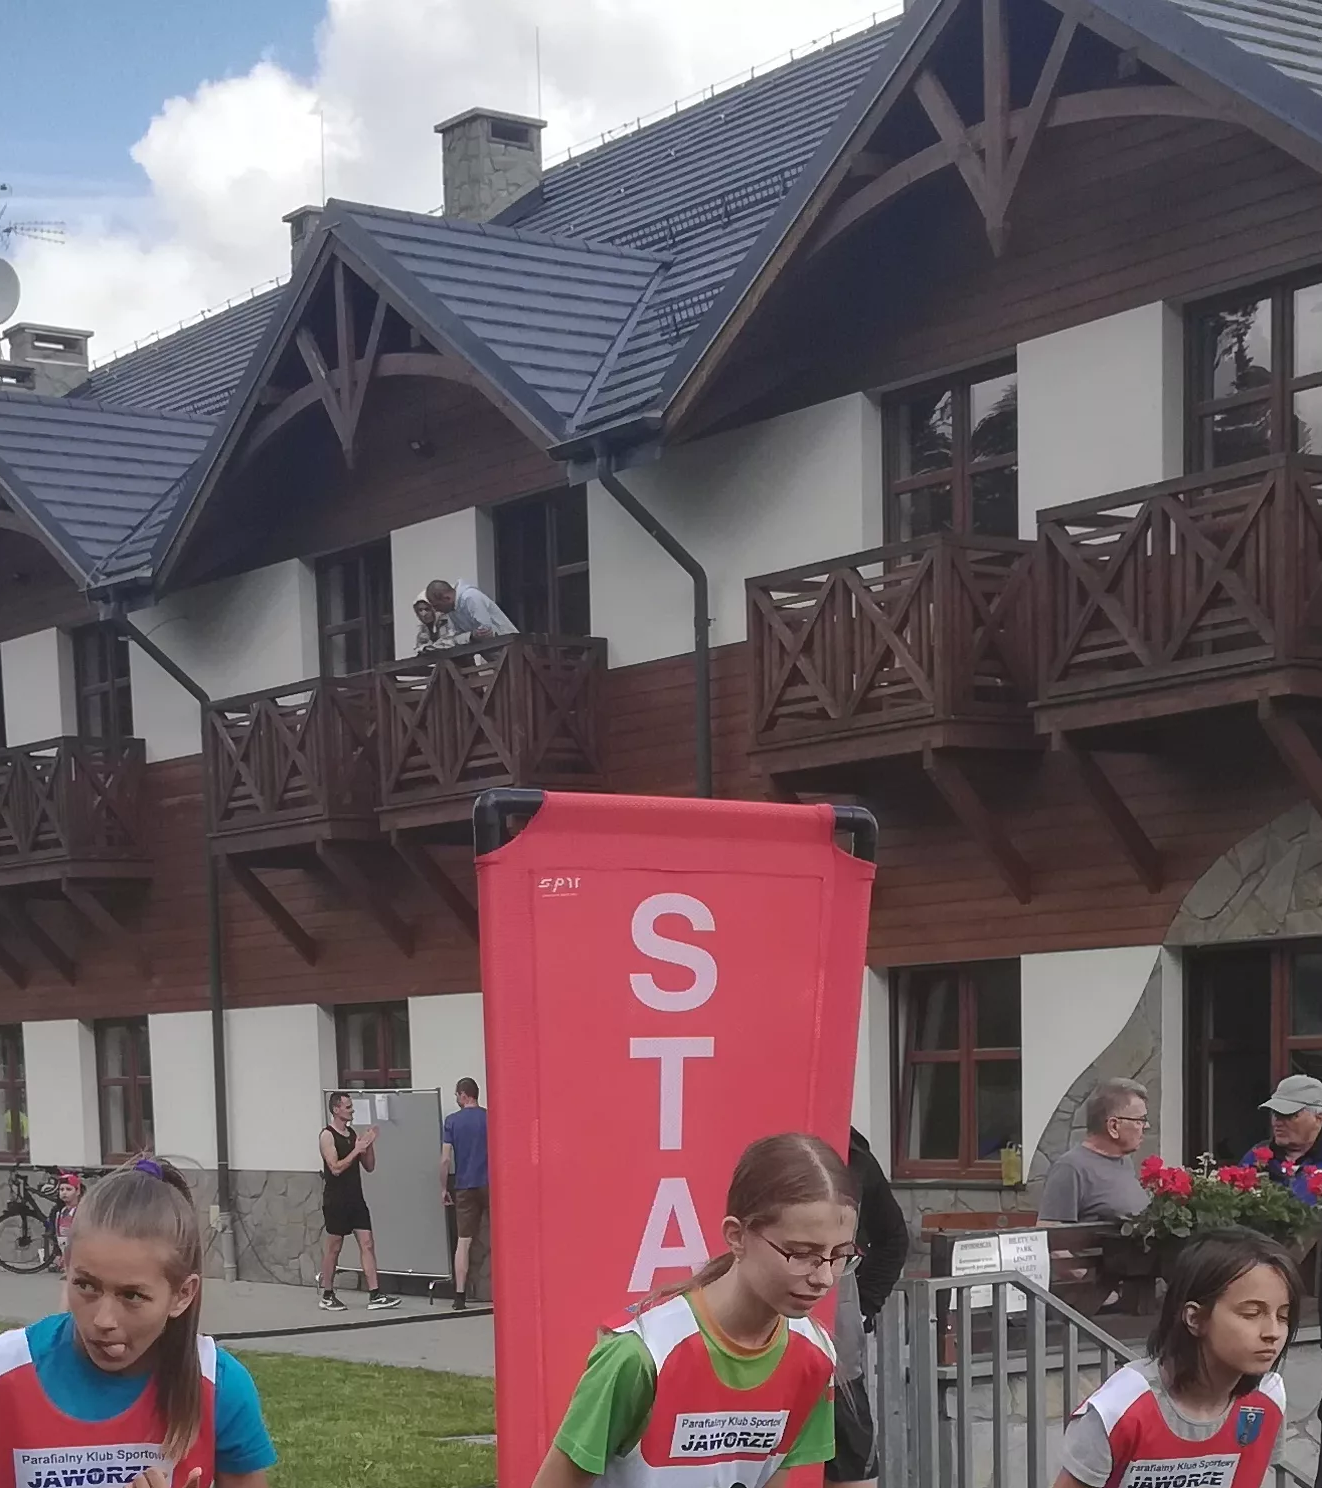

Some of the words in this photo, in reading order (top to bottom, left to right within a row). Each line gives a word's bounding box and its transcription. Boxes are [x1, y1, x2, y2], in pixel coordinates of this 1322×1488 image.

[728, 1416, 748, 1427] Klub
[681, 1431, 777, 1452] JAWORZE
[22, 1453, 83, 1465] Parafialny
[87, 1451, 114, 1462] Klub
[27, 1465, 152, 1488] JAWORZ
